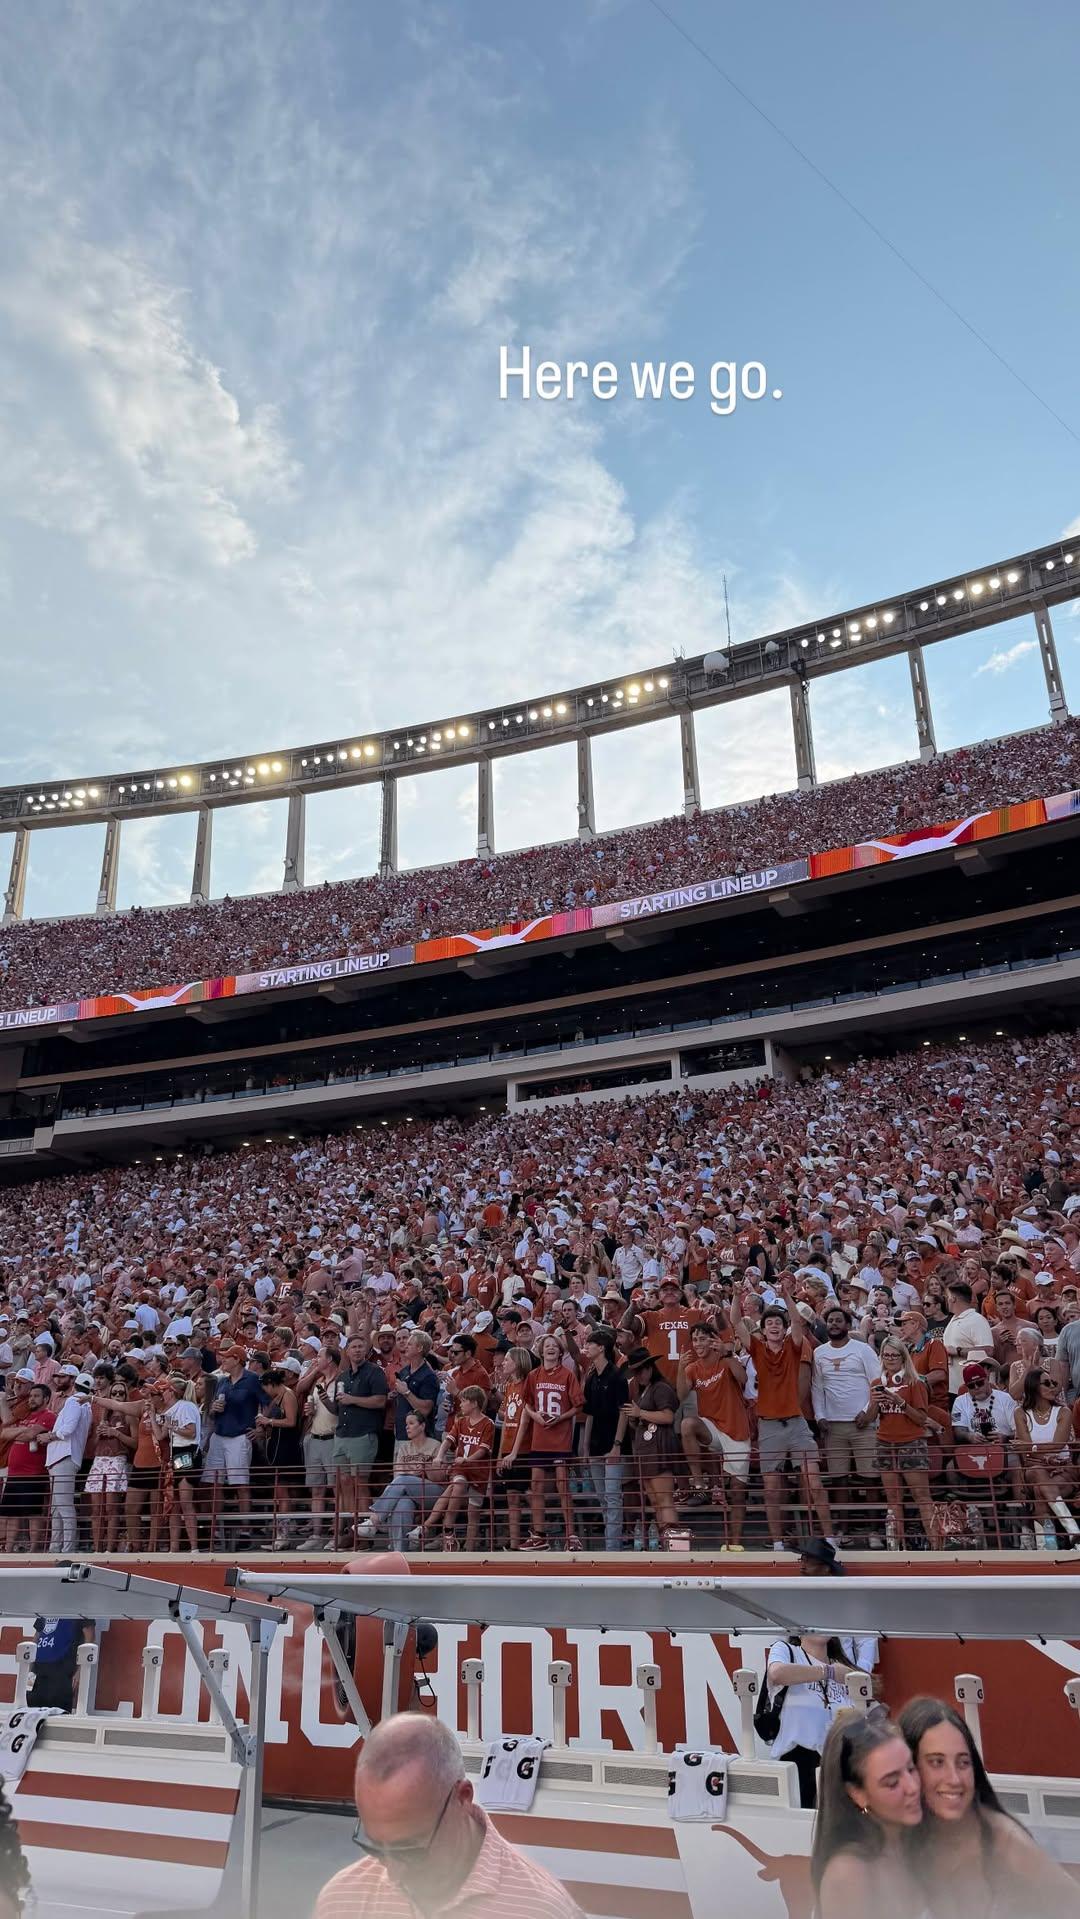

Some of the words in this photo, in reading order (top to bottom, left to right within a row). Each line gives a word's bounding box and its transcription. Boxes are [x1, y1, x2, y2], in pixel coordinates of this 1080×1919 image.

[620, 886, 707, 918] STARTING
[711, 869, 778, 898] LINEUP
[259, 962, 333, 988] STARTING
[336, 952, 390, 975] LINEUP
[6, 1008, 56, 1027] LINEUP
[659, 1321, 689, 1330] TEXAS
[667, 1329, 680, 1360] 1
[537, 1391, 562, 1417] 16
[459, 1434, 480, 1446] TEXAS
[463, 1444, 471, 1459] 1
[37, 1637, 55, 1648] 264
[151, 1656, 159, 1665] G
[475, 1670, 483, 1680] G
[550, 1673, 558, 1683] G
[646, 1675, 655, 1686] G
[748, 1682, 756, 1693] G
[859, 1686, 868, 1696] G
[957, 1687, 965, 1699] G
[9, 1712, 28, 1728] G
[11, 1734, 29, 1753] G
[517, 1757, 538, 1780] G
[705, 1771, 725, 1797] G
